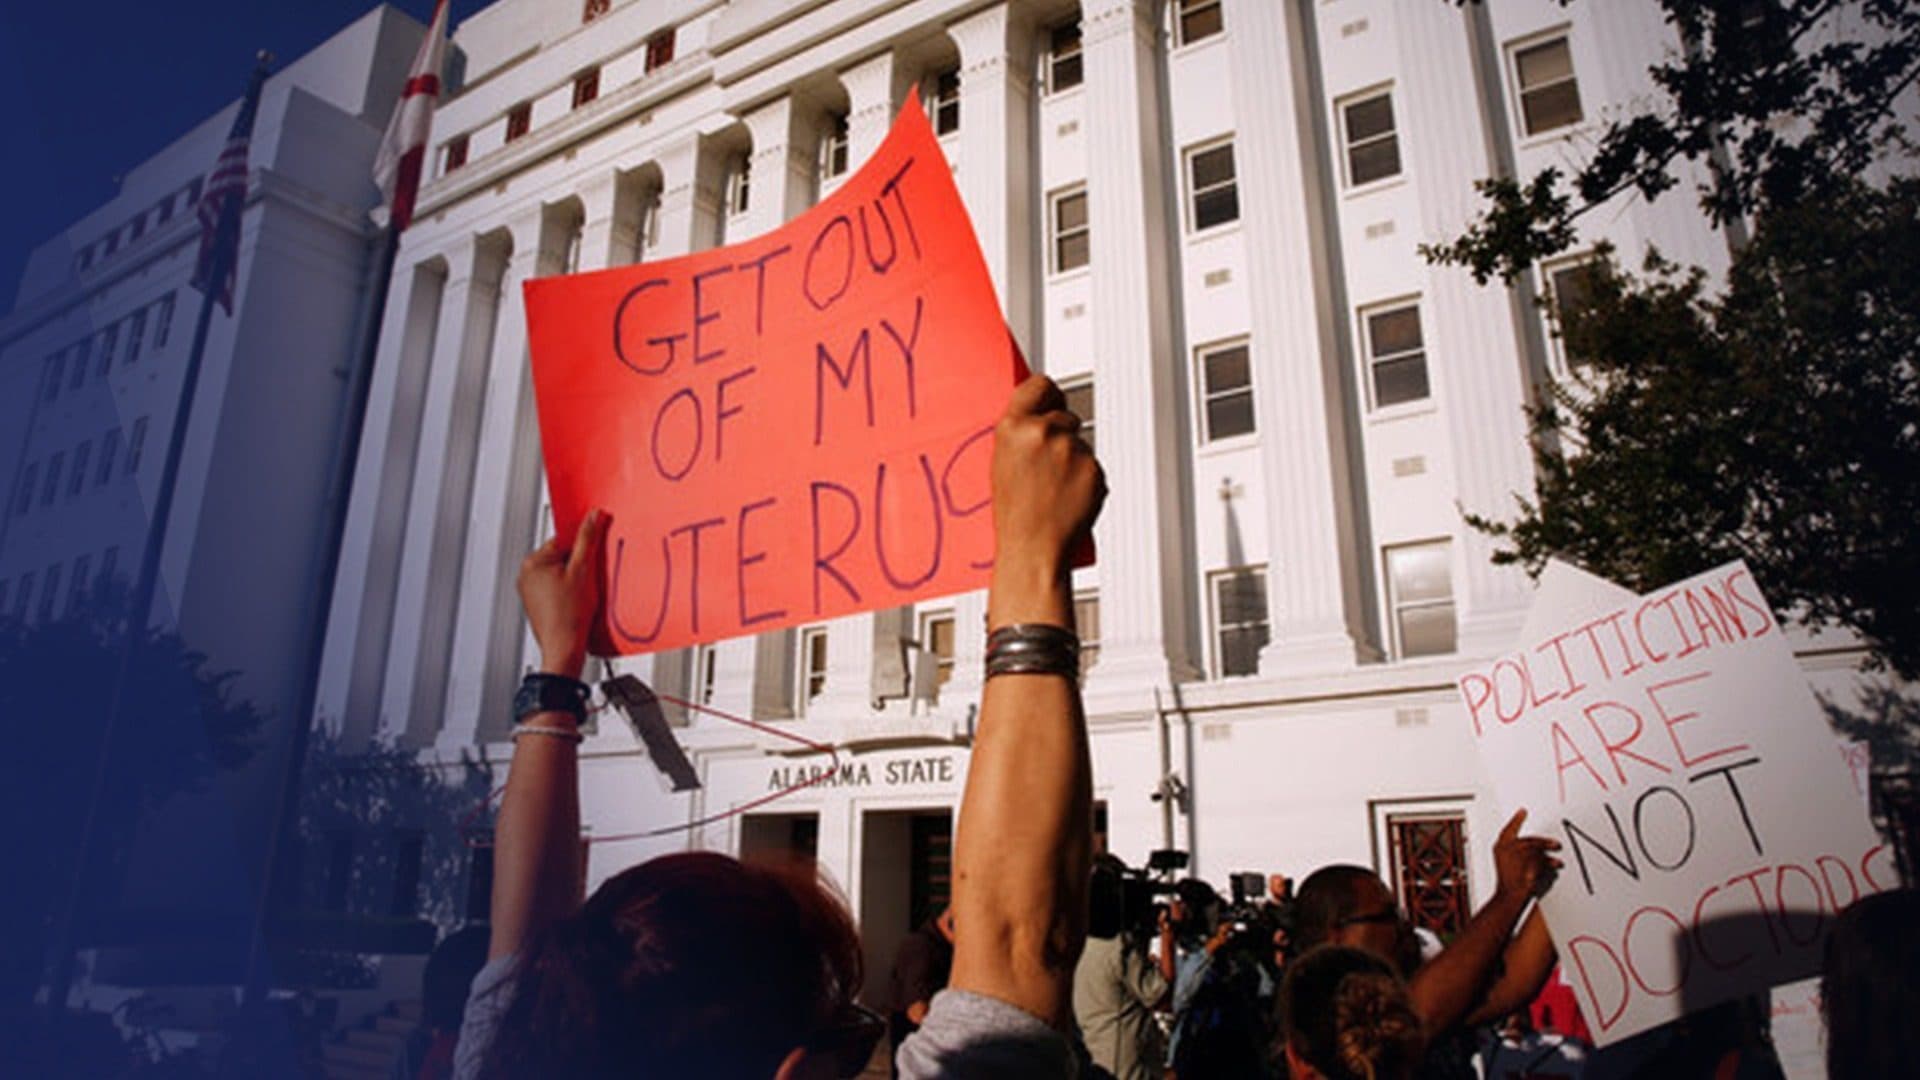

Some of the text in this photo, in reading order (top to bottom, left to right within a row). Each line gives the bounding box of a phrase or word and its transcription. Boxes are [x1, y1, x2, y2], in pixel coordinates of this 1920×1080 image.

[613, 156, 920, 375] GET OUT
[651, 296, 924, 482] OF MY
[1459, 569, 1772, 737] POLITICIANS
[768, 756, 954, 791] ALABAMA STATE
[1550, 671, 1750, 803] ARE
[1561, 758, 1761, 895] NOT
